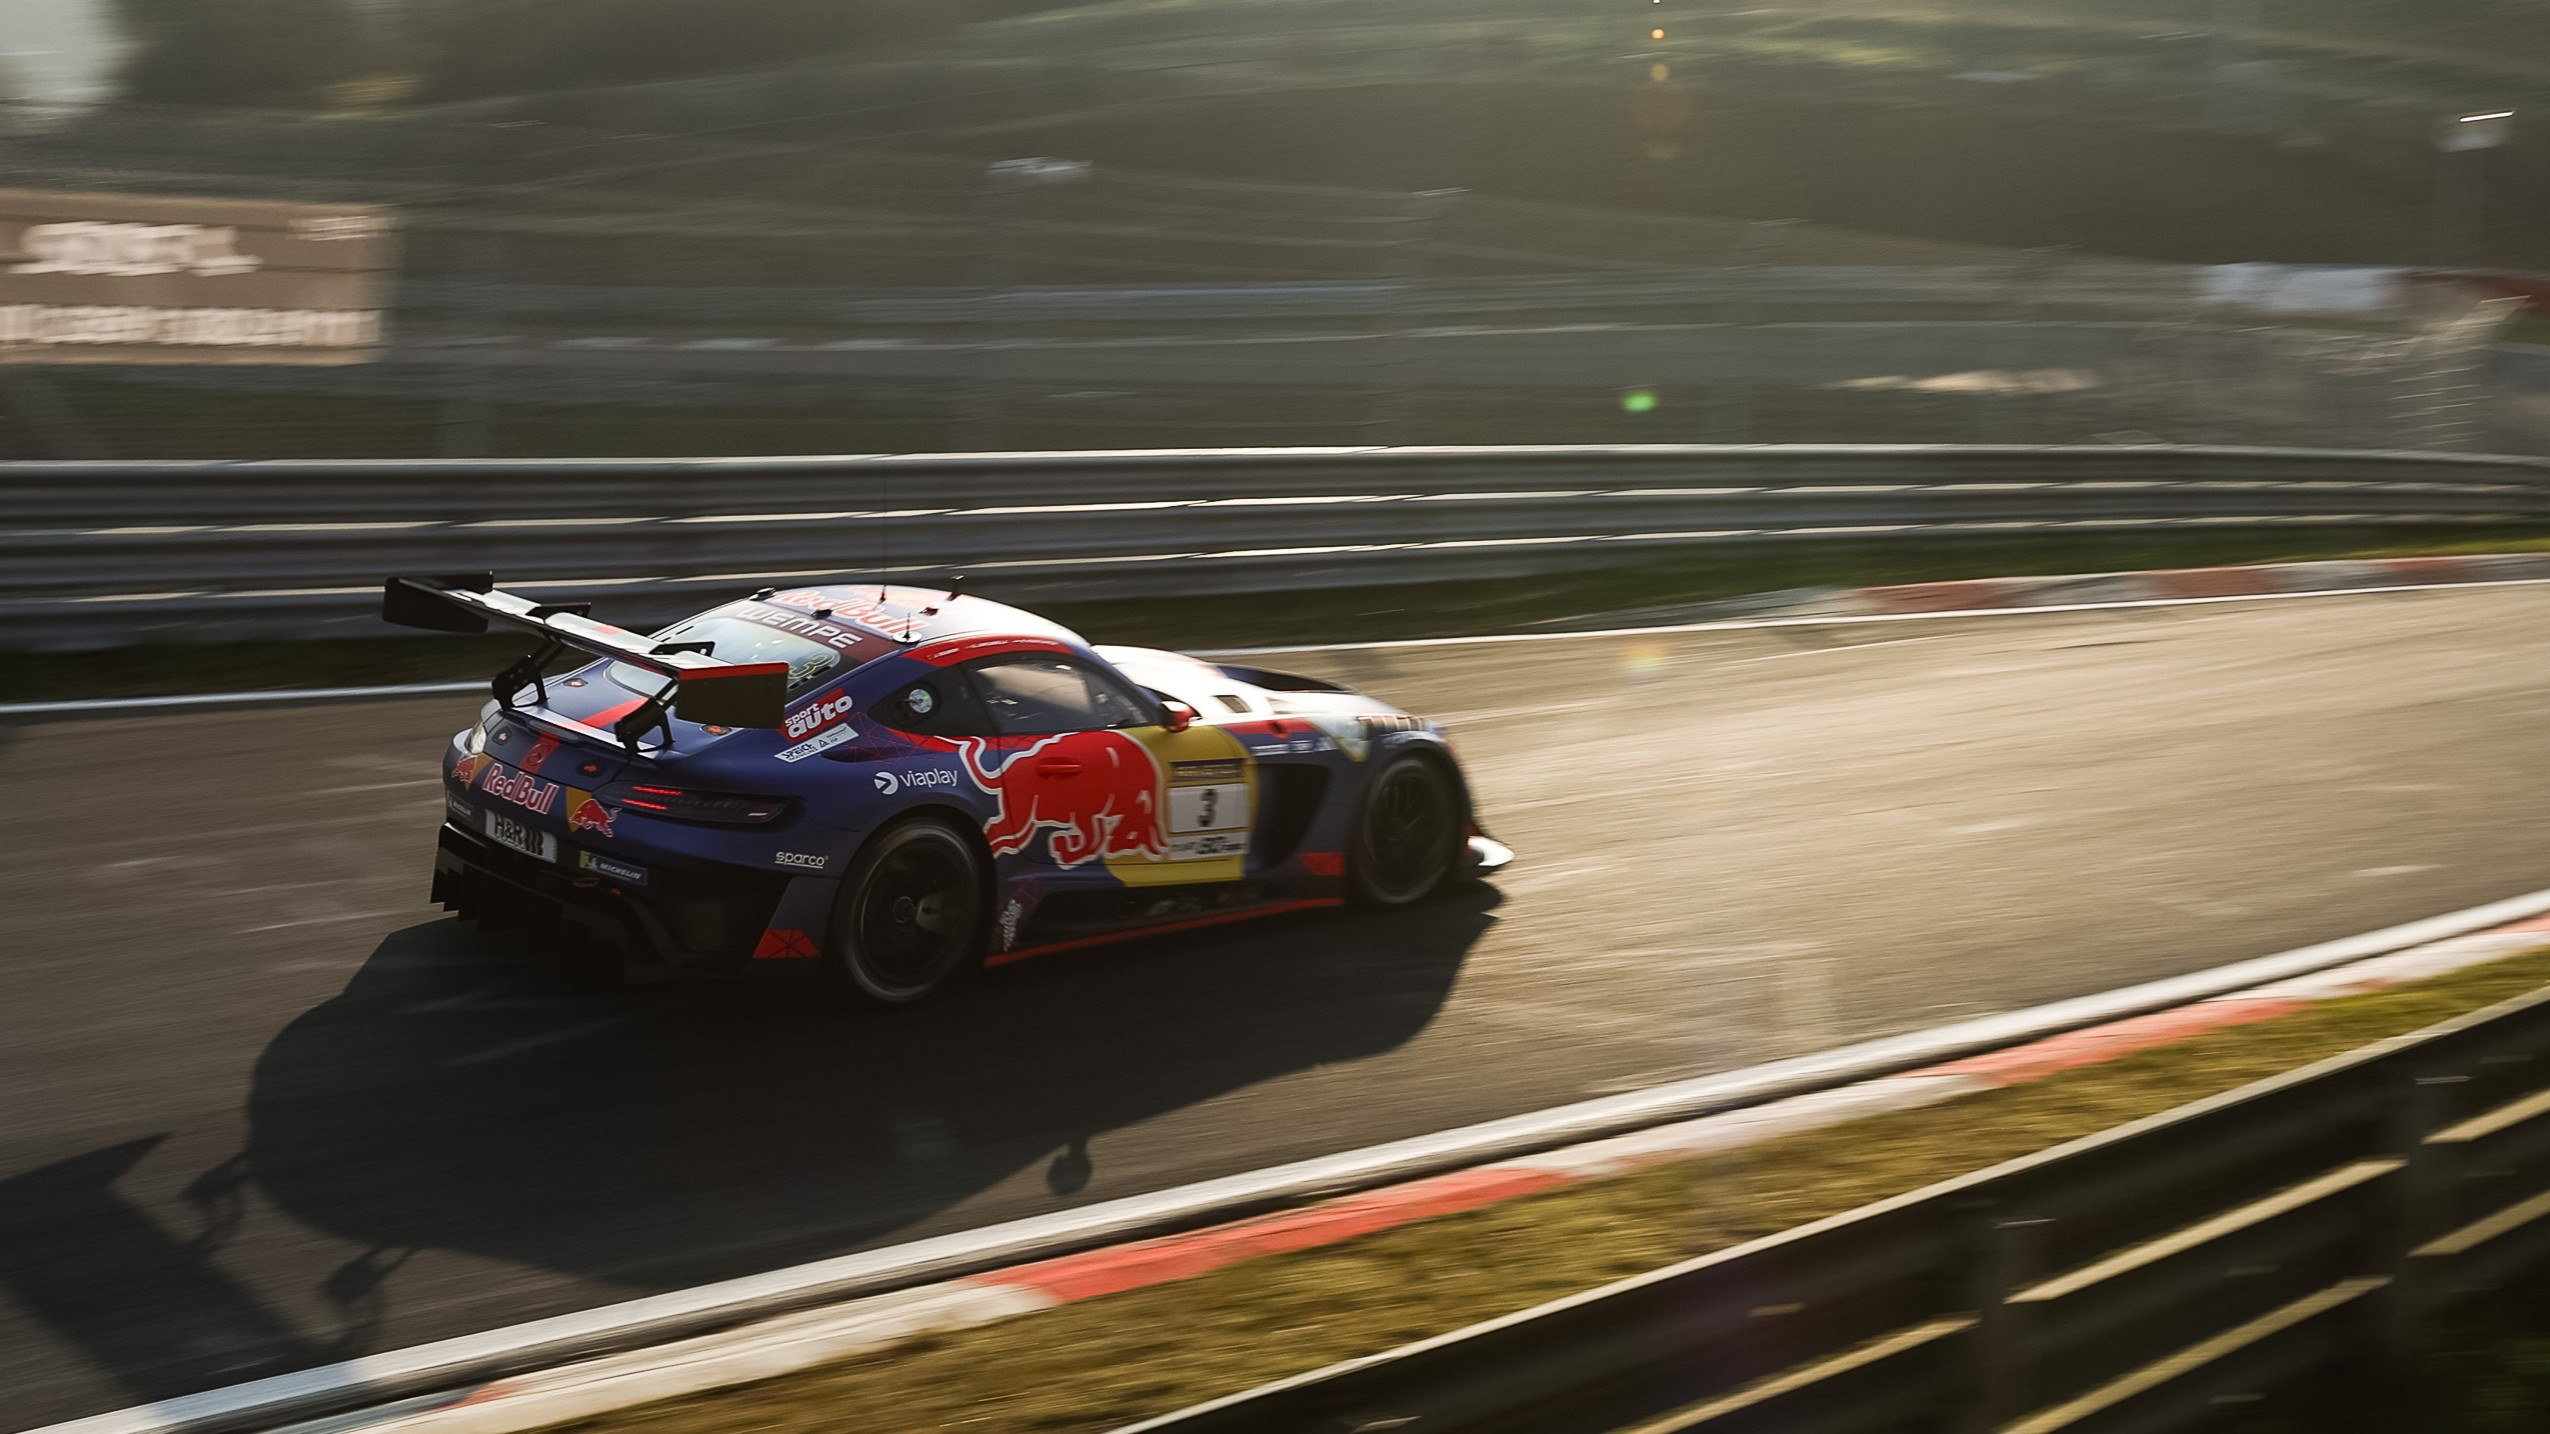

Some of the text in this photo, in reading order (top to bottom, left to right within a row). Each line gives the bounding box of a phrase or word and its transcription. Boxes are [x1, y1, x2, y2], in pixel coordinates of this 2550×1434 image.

[736, 608, 863, 648] WEMPE
[785, 703, 819, 727] sport
[788, 696, 853, 738] auto
[900, 768, 957, 787] viaplay
[1198, 788, 1217, 827] 3
[775, 851, 825, 866] sparco
